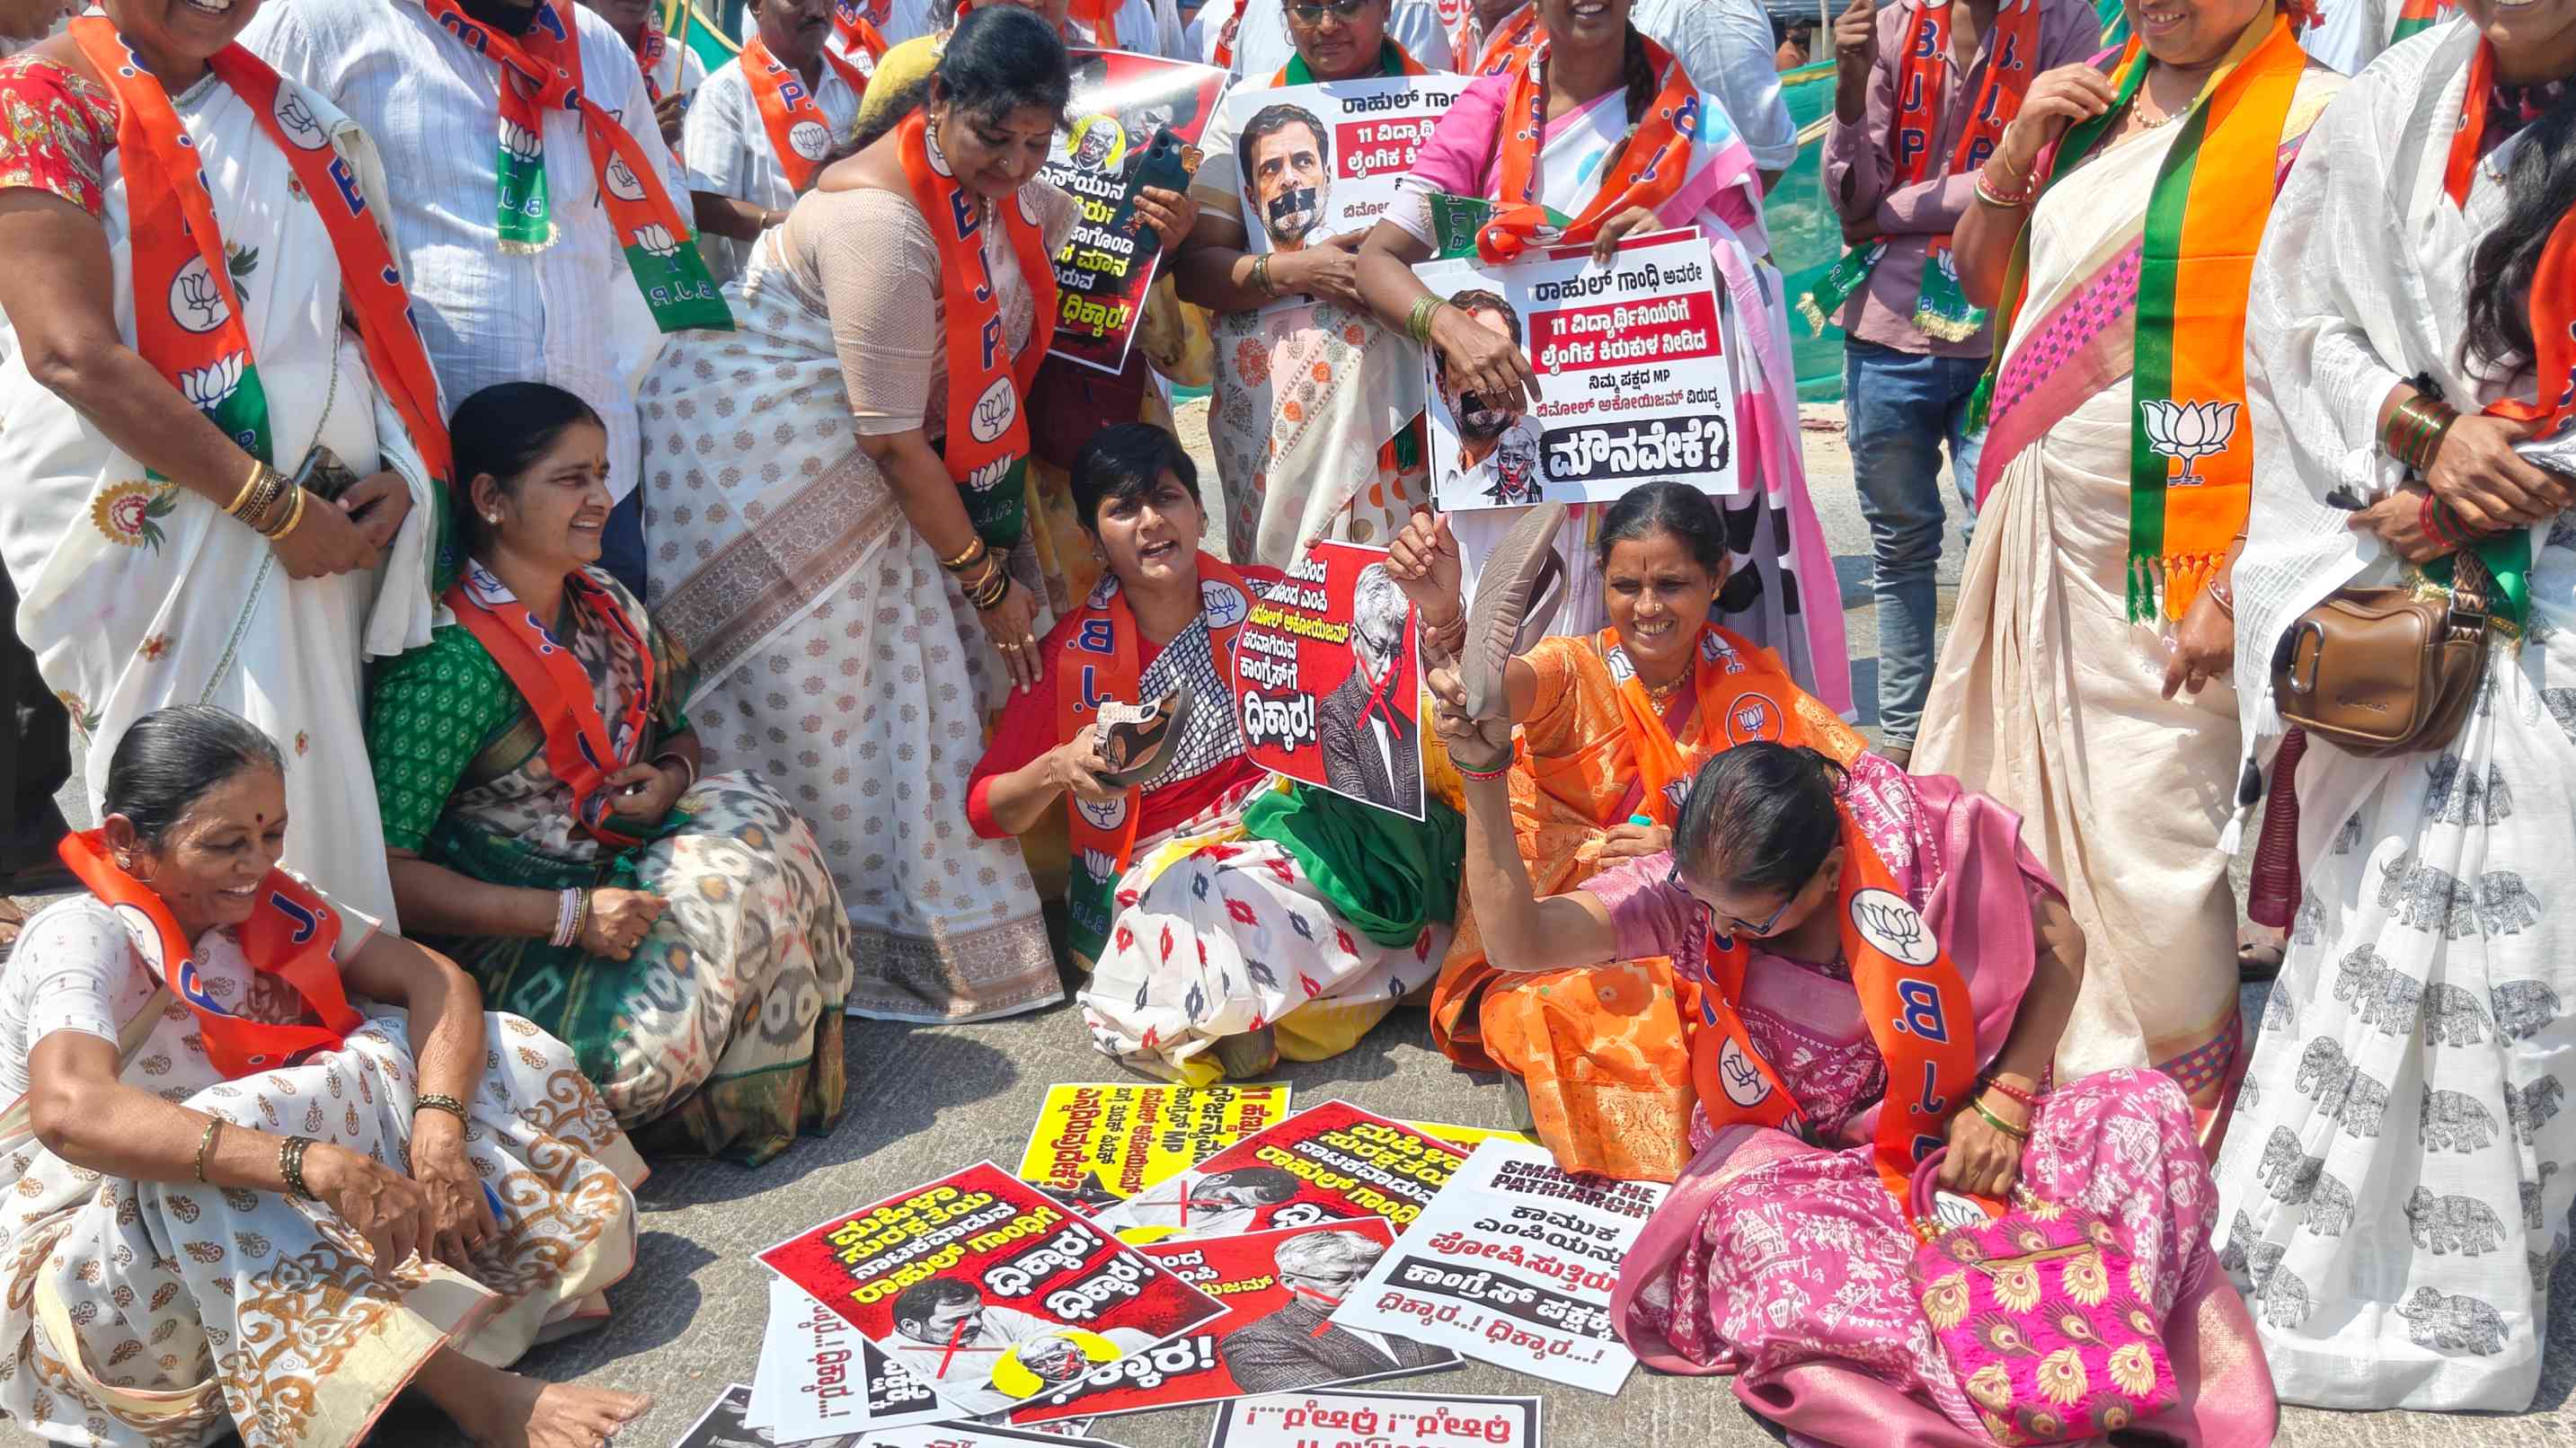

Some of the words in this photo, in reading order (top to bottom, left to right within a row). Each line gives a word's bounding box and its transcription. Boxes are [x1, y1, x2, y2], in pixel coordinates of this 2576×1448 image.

[1342, 90, 1419, 114] ರಾಹುಲ್
[1357, 128, 1372, 144] 11
[1348, 147, 1400, 178] ಲೈಂಗಿಕ
[1535, 269, 1613, 302] ರಾಹುಲ್
[1616, 262, 1660, 293] ಗಾಂಧಿ
[1663, 262, 1703, 285] ಅವರೇ
[1551, 317, 1566, 336] 11
[1571, 298, 1691, 339] ವಿದ್ಯಾರ್ಥಿನಿಯರಿಗೆ
[1541, 340, 1595, 375] ಲೈಂಗಿಕ
[1598, 335, 1659, 360] ಕಿರುಕುಳ
[1662, 329, 1707, 354] ನೀಡಿದ
[1589, 375, 1621, 393] ನಿಮ್ಮ
[1621, 371, 1651, 391] ಪಕ್ಷದ
[1653, 369, 1670, 383] MP
[1536, 398, 1595, 418] ಬಿಮೋಲ್
[1598, 390, 1683, 412] ಅಕೋಯಿಜಮ್
[1686, 386, 1722, 411] ವಿರುದ್ಧ
[1549, 418, 1725, 478] ಮೌನವೇಕೆ?
[1244, 690, 1316, 752] ಧಿಕ್ಕಾರ!
[1140, 1088, 1166, 1124] ಬಿಮೋಲ್
[1241, 1085, 1272, 1100] 11
[1161, 1130, 1187, 1152] MP
[1254, 1144, 1360, 1190] ರಾಹುಲ್
[828, 1186, 959, 1247] ಮಹಿಳಾ
[837, 1191, 994, 1264] ಸುರಕ್ಷತೆಯ
[1510, 1205, 1621, 1242] ಕಾಮುಕ
[850, 1244, 966, 1304] ರಾಹುಲ್
[966, 1205, 1065, 1254] ಗಾಂಧಿಗೆ
[851, 1201, 1018, 1280] ನಾಟಕವಾಡುವ
[984, 1221, 1104, 1297] ಧಿಕ್ಕಾರ!
[1046, 1249, 1155, 1320] ಧಿಕ್ಕಾರ!
[1403, 1263, 1538, 1305] ಕಾಂಗ್ರೆಸ್
